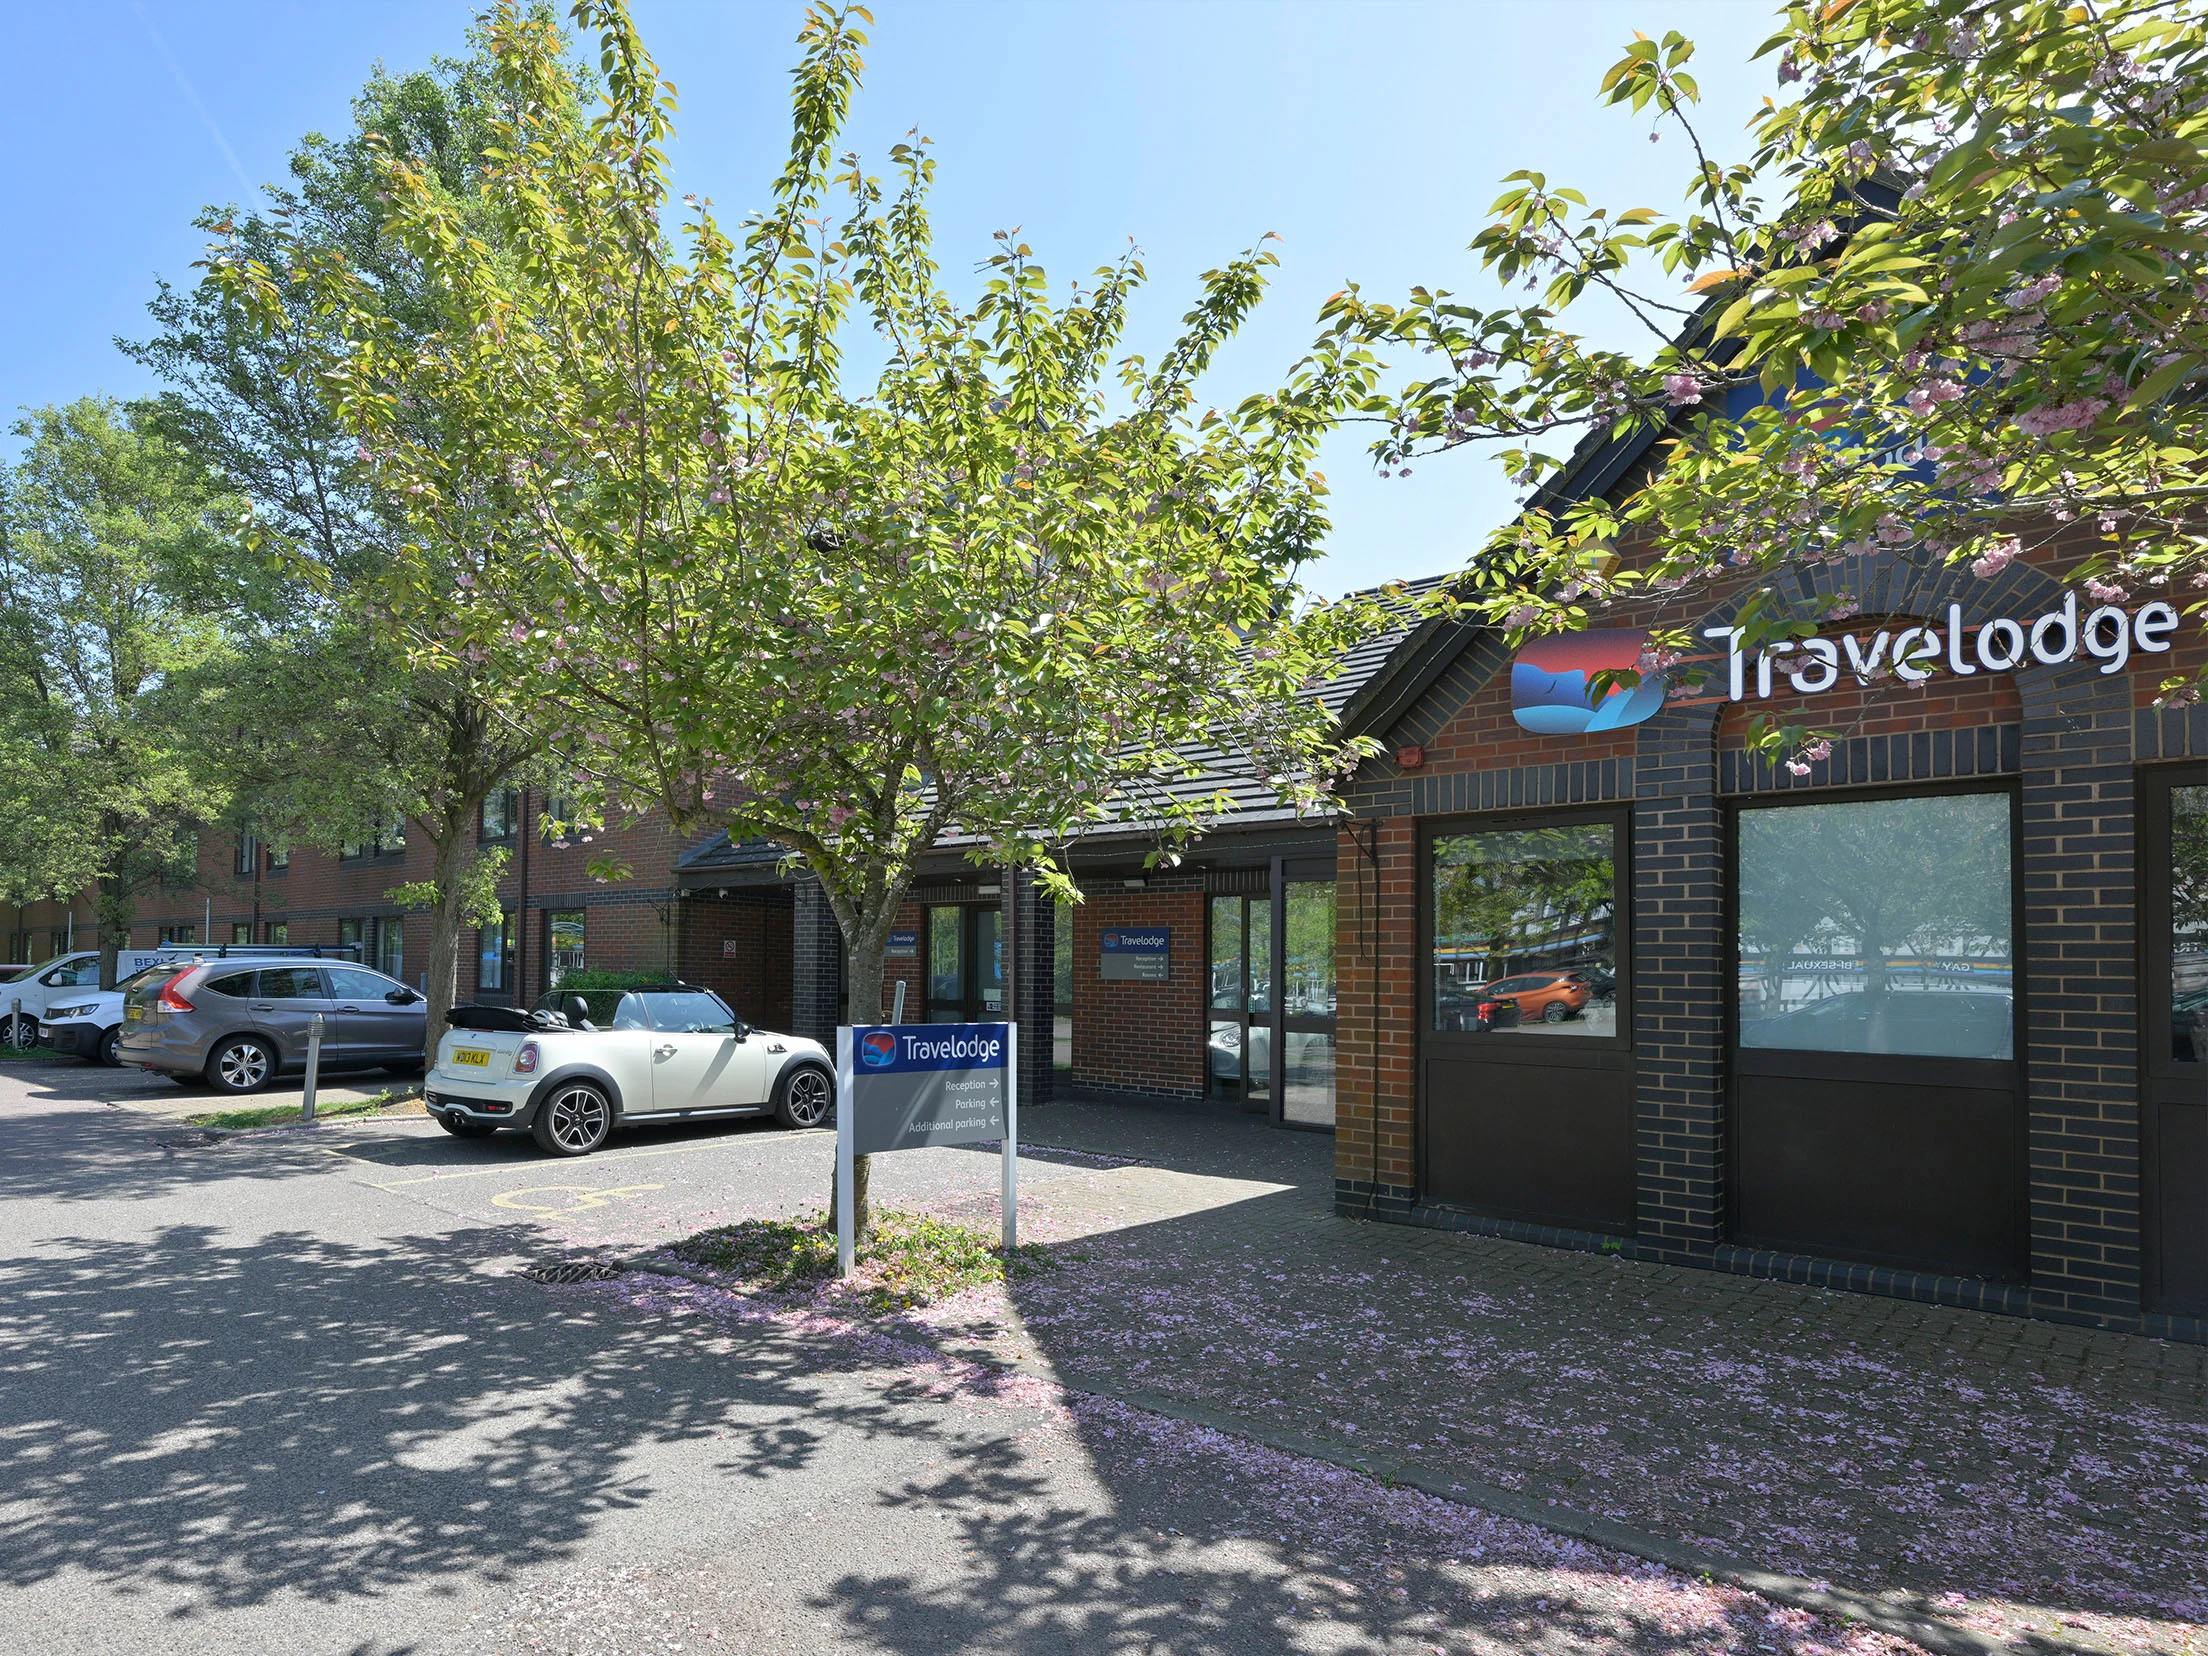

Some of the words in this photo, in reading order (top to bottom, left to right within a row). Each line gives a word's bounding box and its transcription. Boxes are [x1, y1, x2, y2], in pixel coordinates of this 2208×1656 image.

[1704, 590, 2180, 701] Travelodge
[1121, 935, 1164, 948] Travelodge
[902, 1034, 1000, 1062] Travelodge
[945, 1080, 986, 1092] Reception
[955, 1098, 986, 1110] Parking
[908, 1119, 953, 1133] Additional
[955, 1117, 986, 1130] parking
